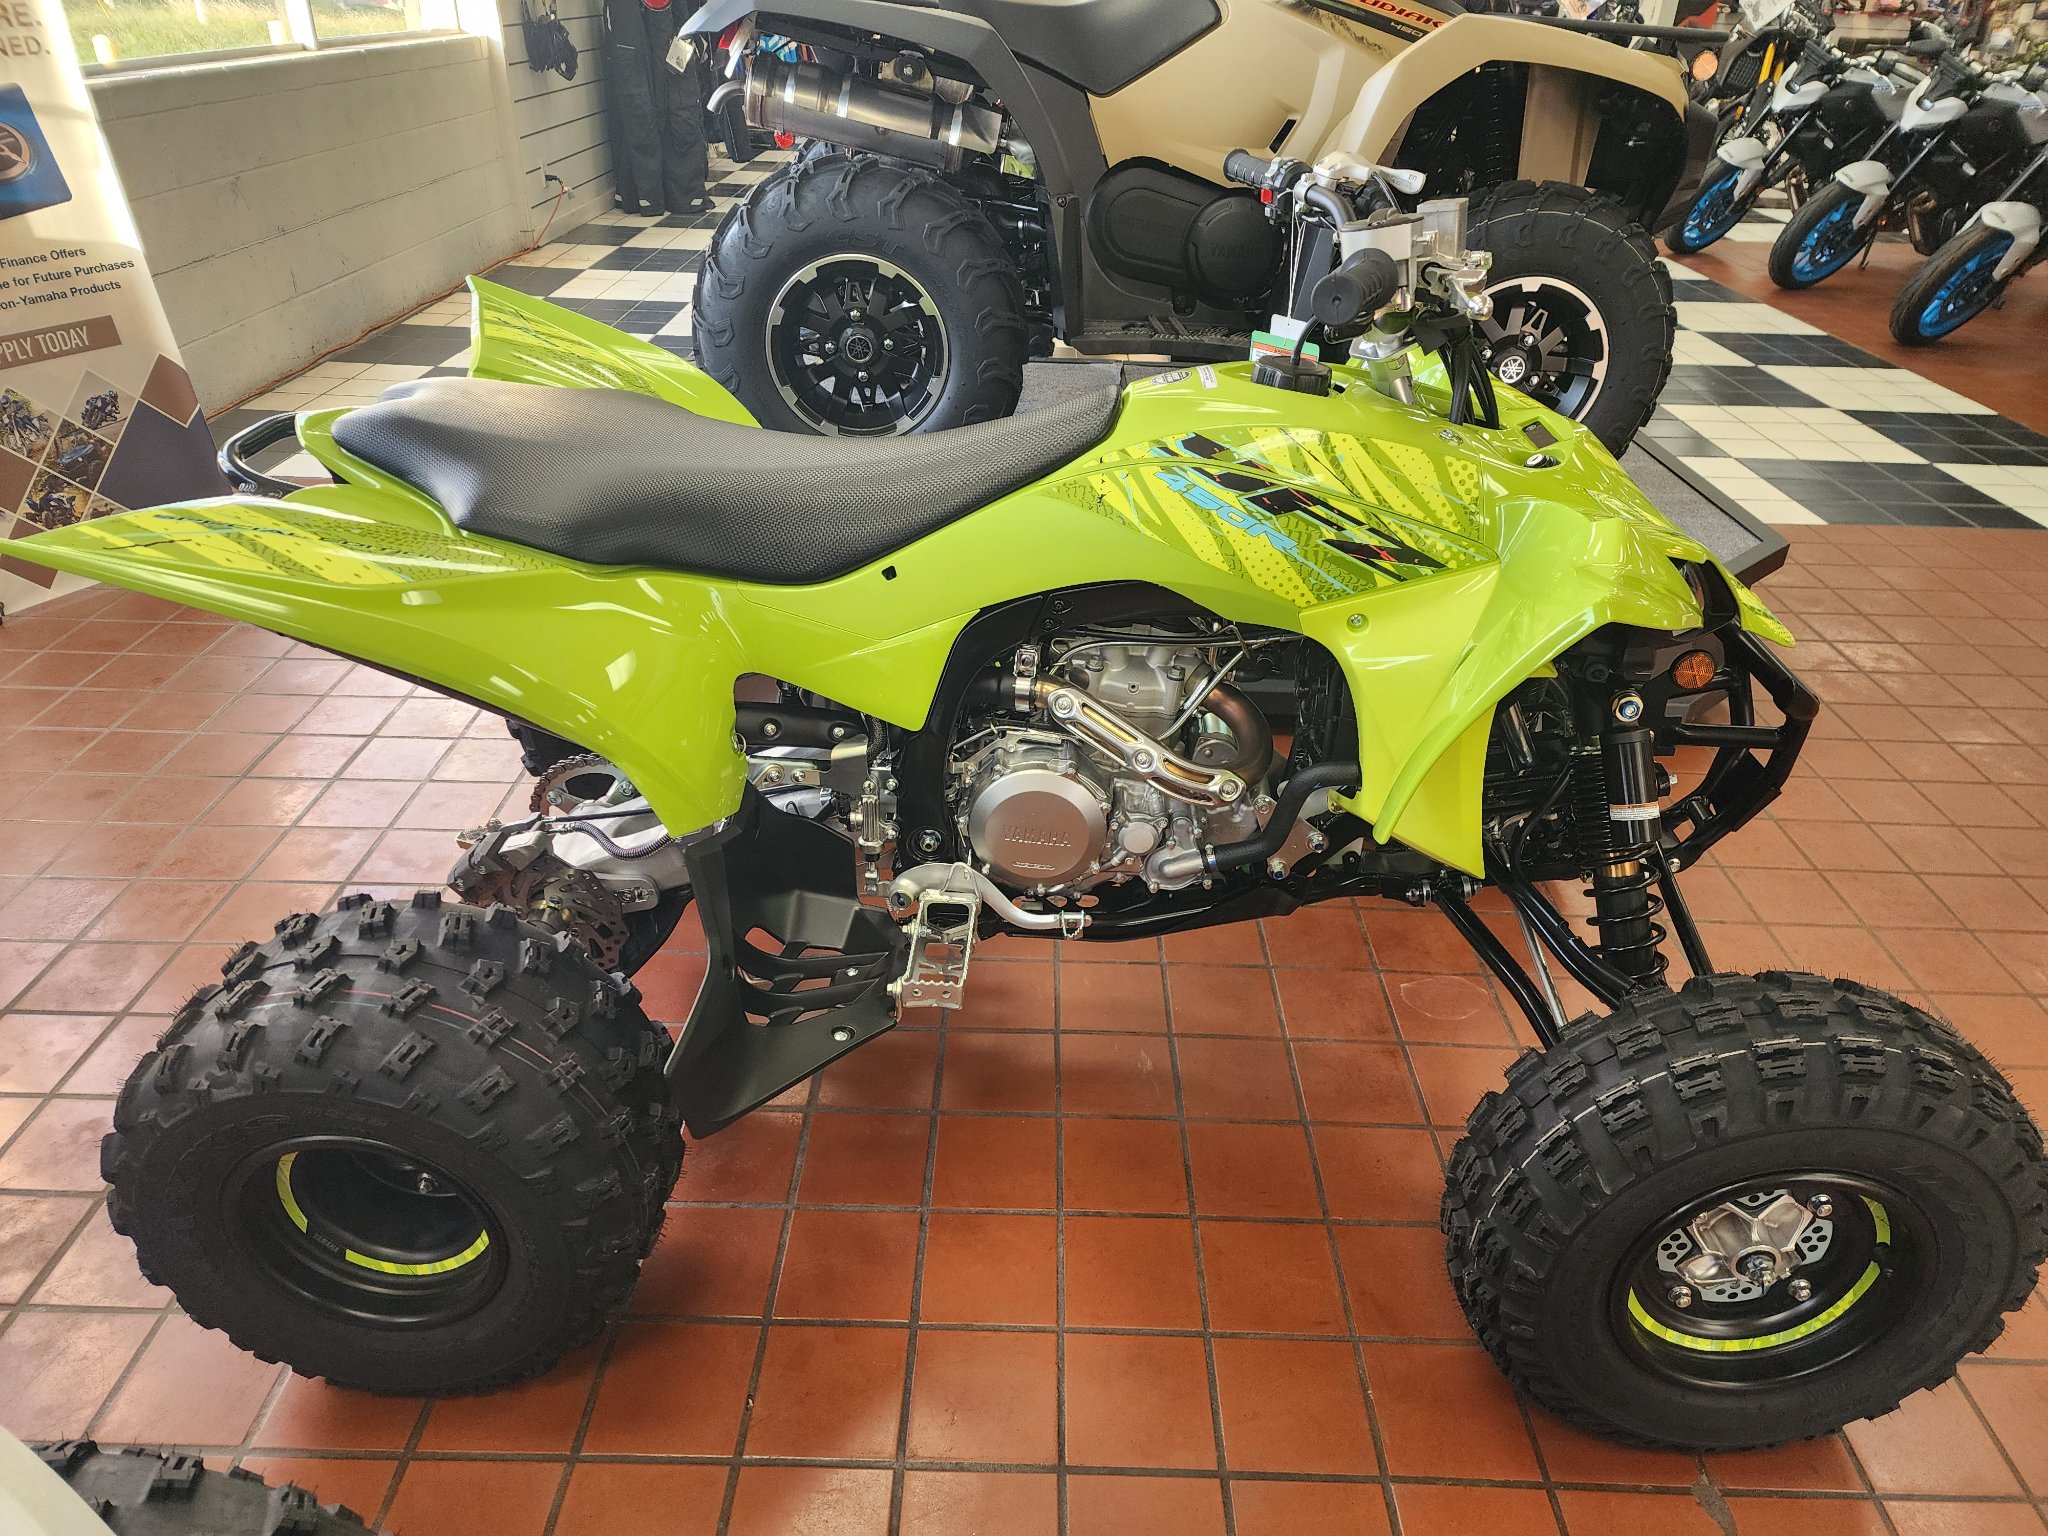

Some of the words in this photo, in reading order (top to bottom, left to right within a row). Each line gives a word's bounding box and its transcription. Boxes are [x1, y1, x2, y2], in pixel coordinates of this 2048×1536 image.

[1390, 21, 1424, 37] 450
[0, 254, 48, 268] Finance
[50, 248, 86, 260] Offers
[13, 276, 30, 287] for
[33, 270, 72, 283] Future
[74, 259, 135, 276] Purchases
[0, 291, 68, 310] on-Yamaha
[70, 280, 122, 297] Products
[0, 337, 33, 364] PLY
[35, 325, 90, 354] TODAY
[1001, 824, 1071, 847] YAMAHA
